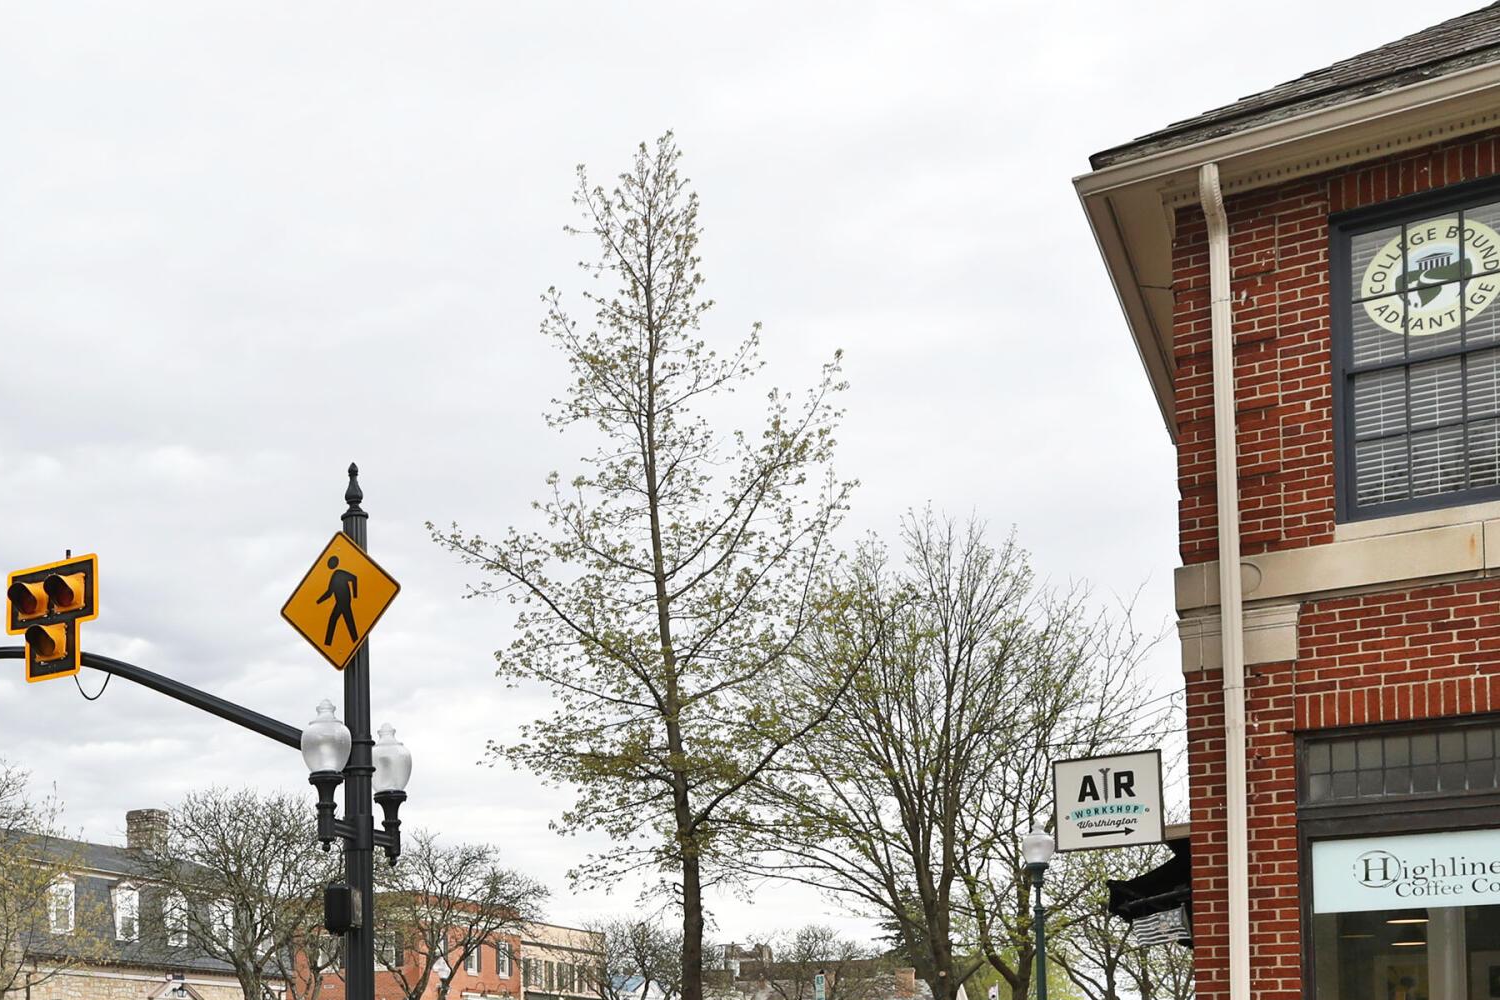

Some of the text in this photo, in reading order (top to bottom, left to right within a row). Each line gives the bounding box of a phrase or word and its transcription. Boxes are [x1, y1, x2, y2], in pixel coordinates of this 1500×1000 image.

[1445, 225, 1499, 271] BOUND
[1074, 804, 1140, 819] WORKSHOP
[1076, 817, 1138, 830] Worthington
[1362, 856, 1500, 886] Highline
[1395, 880, 1464, 898] Coffee
